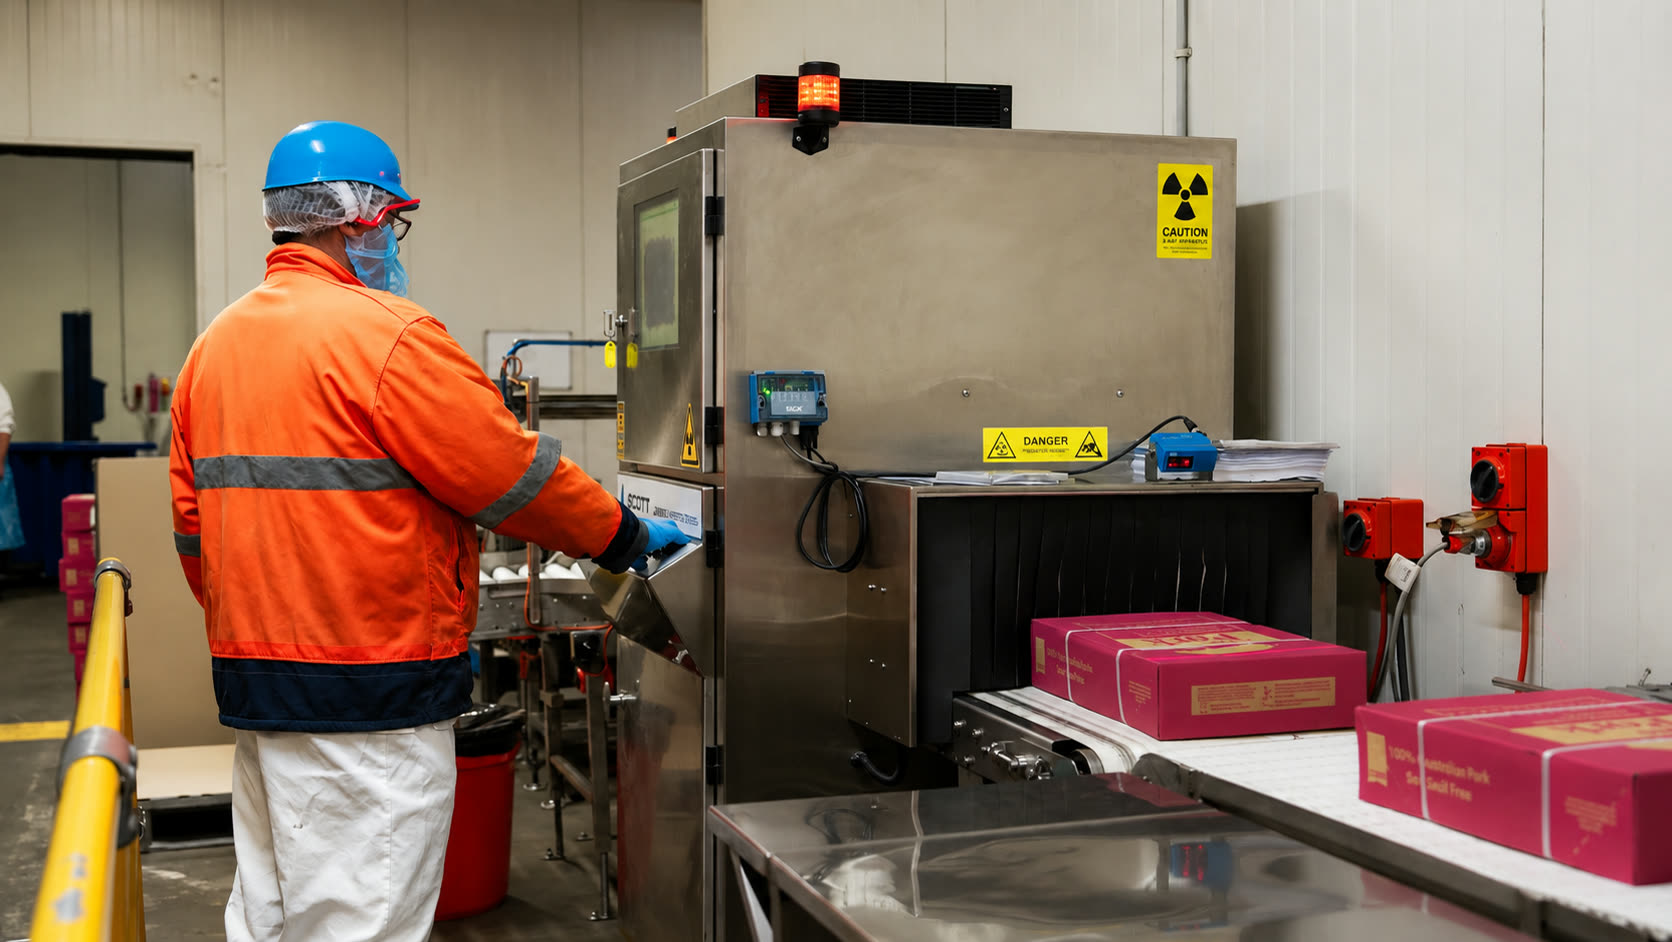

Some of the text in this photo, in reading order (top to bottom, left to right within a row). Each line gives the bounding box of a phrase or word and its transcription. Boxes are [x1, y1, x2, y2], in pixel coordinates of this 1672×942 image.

[1162, 226, 1208, 238] CAUTION
[1023, 436, 1069, 446] DANGER
[627, 493, 650, 514] SCOTT
[1388, 745, 1417, 765] 100%
